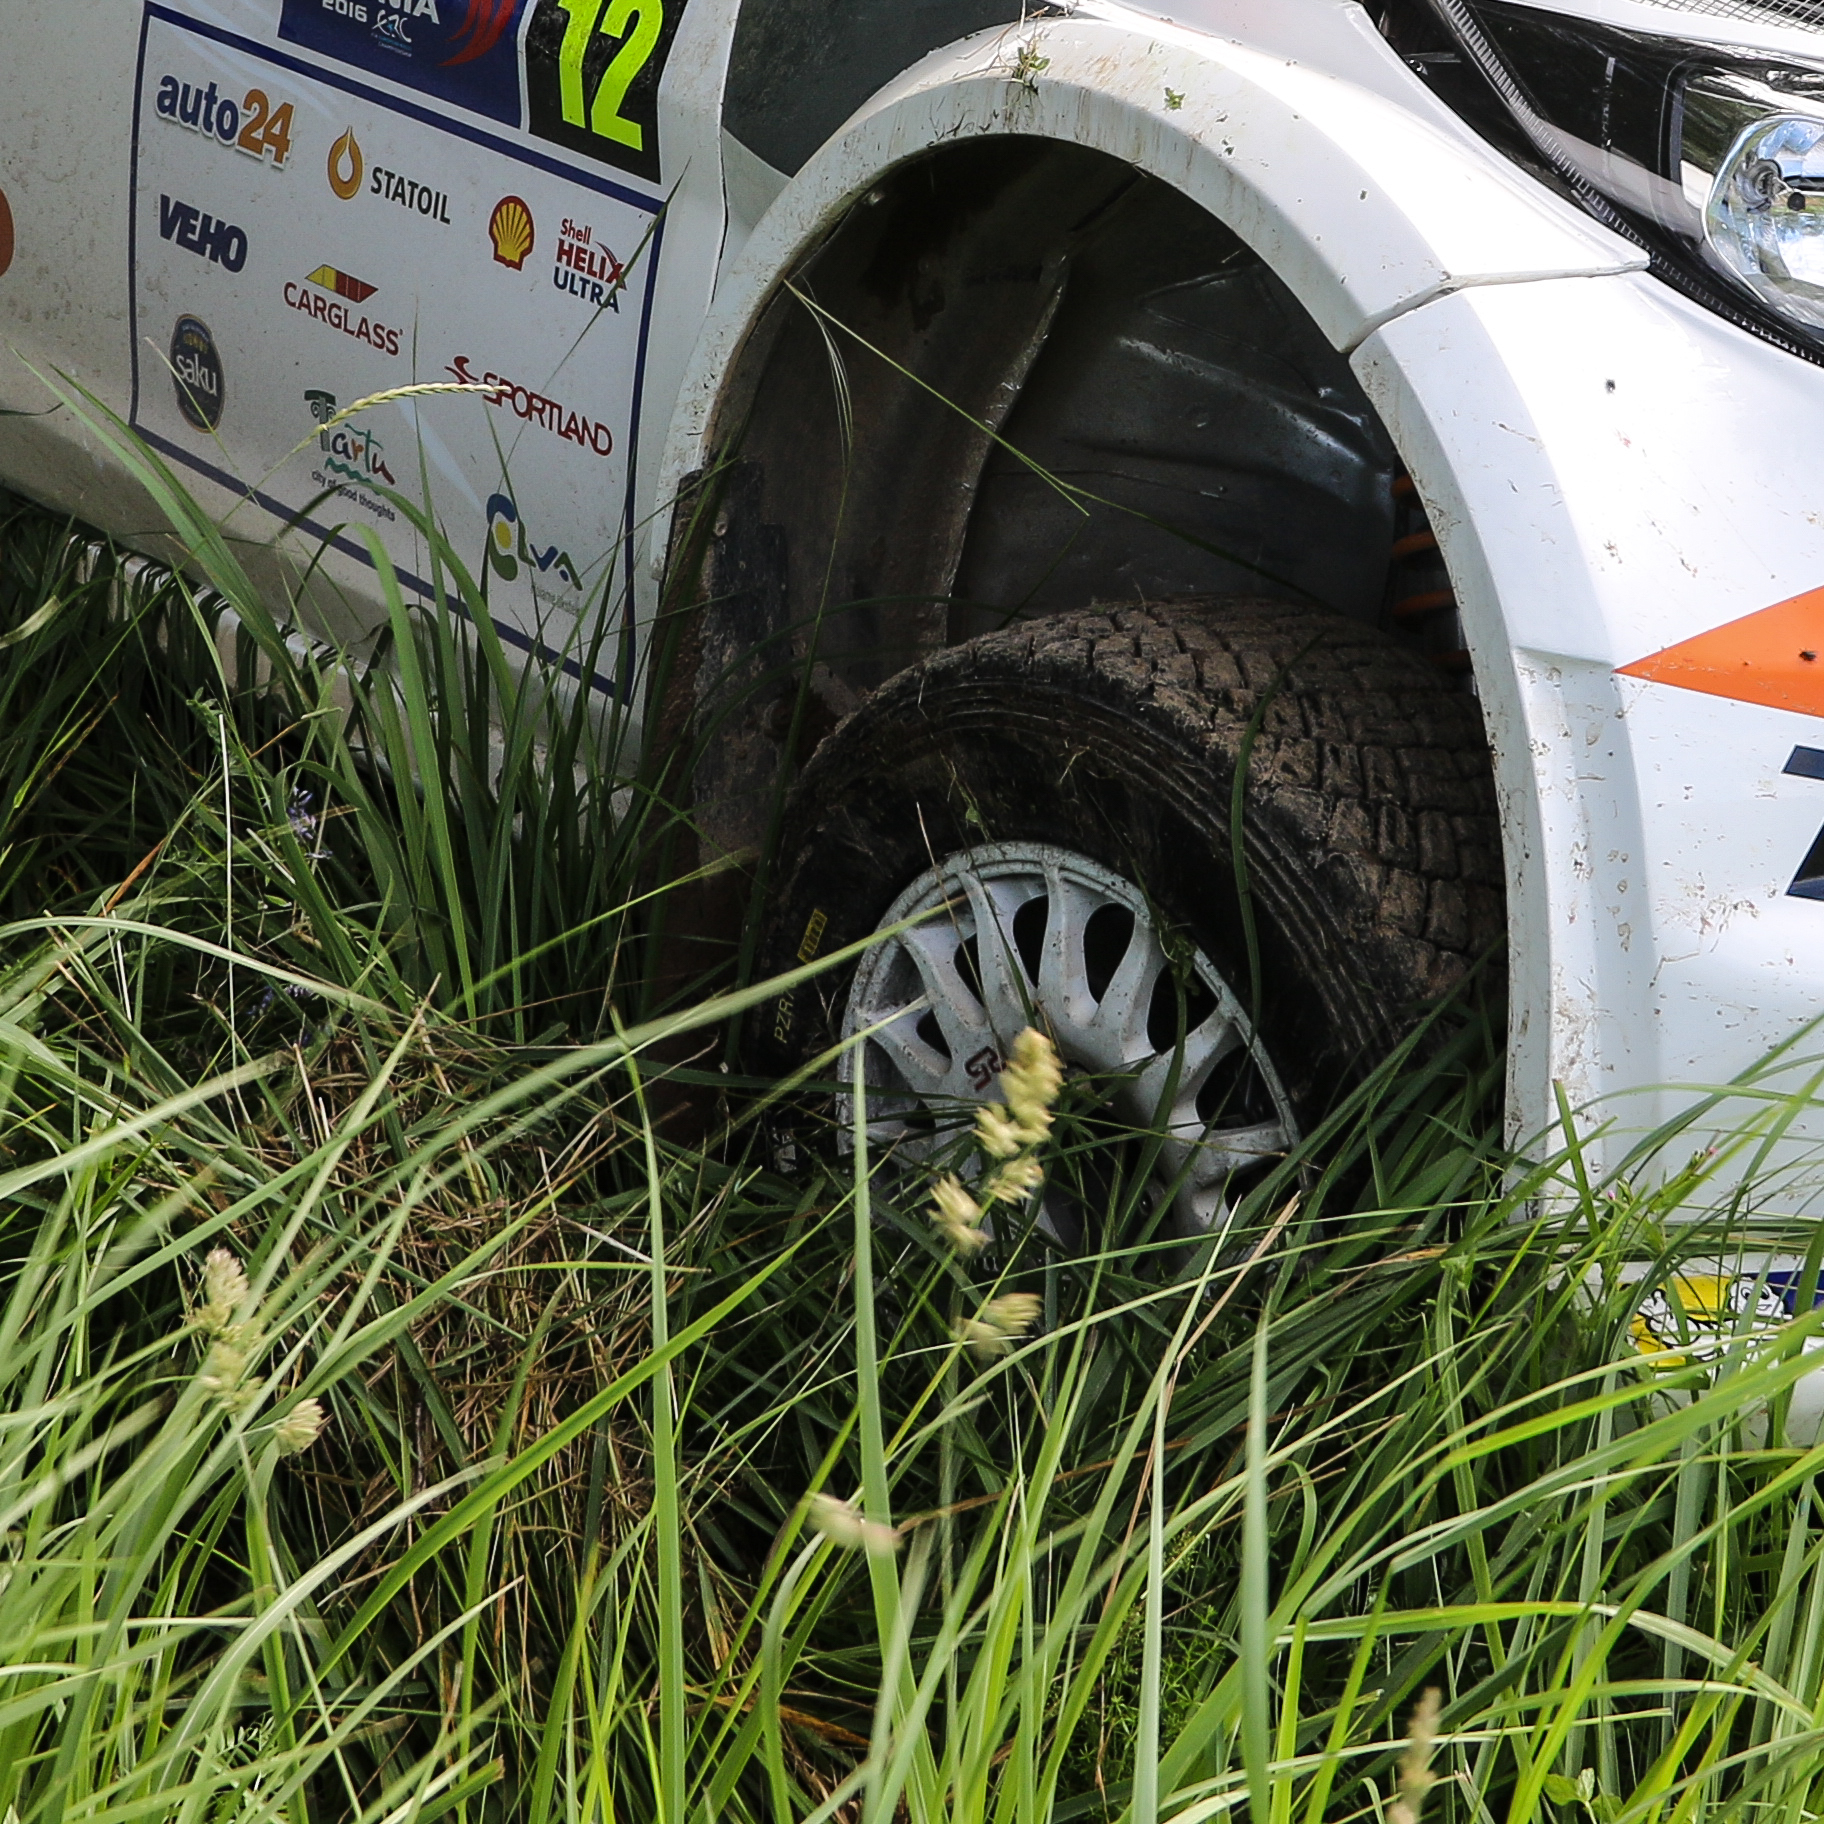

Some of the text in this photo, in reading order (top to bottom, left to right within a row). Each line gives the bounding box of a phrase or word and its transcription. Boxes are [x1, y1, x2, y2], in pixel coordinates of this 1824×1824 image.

[156, 73, 296, 170] auto24
[370, 165, 452, 226] STATOIL
[159, 193, 249, 274] VEHO
[560, 218, 592, 245] Shell
[553, 265, 620, 314] ULTRA
[556, 237, 628, 291] HELIX
[176, 352, 218, 397] saku
[303, 389, 396, 486] Tartu
[482, 372, 613, 457] SPORTLAND
